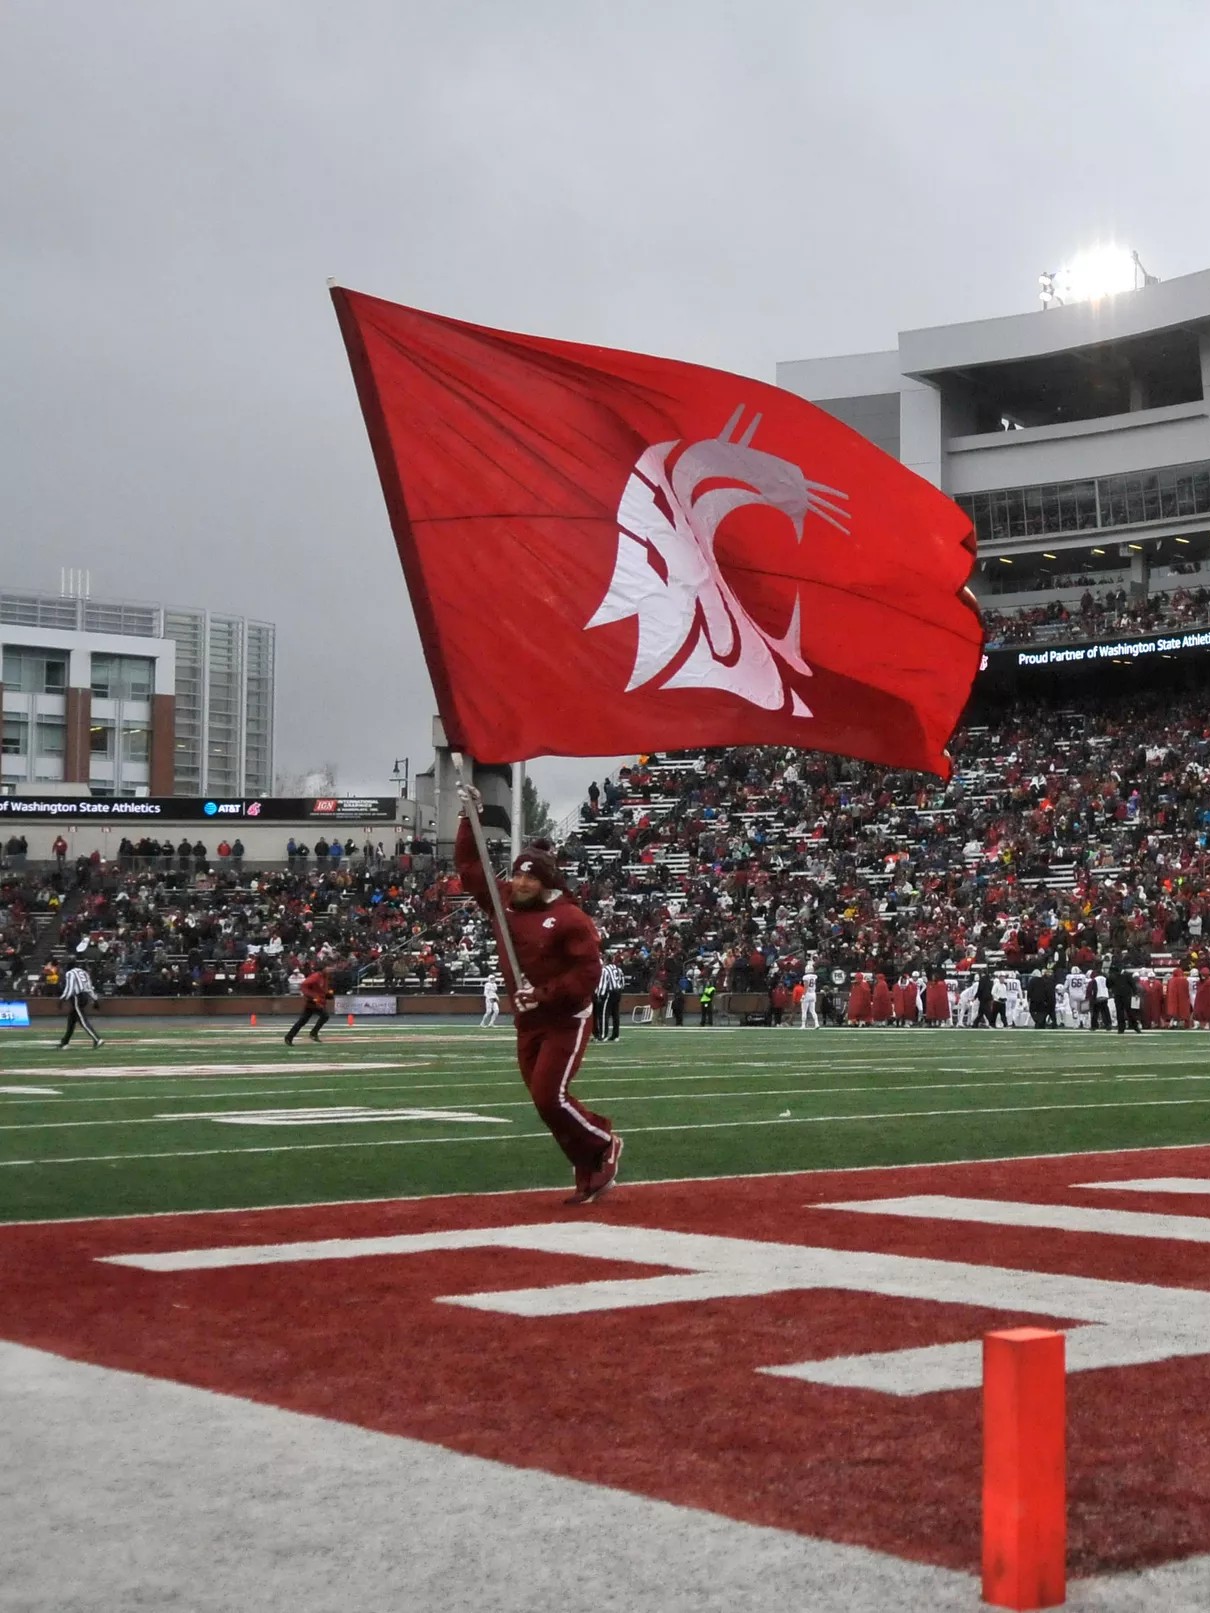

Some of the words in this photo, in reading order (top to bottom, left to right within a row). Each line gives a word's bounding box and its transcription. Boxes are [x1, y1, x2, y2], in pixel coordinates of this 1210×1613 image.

[1018, 651, 1049, 665] Proud
[1050, 648, 1086, 662] Partner
[1087, 646, 1099, 659] of
[1099, 640, 1156, 658] Washington
[1157, 636, 1181, 650] State
[11, 802, 77, 814] Washington
[79, 802, 110, 813] State
[111, 803, 161, 813] Athletics
[217, 804, 241, 813] AT&T
[1070, 977, 1083, 988] 66
